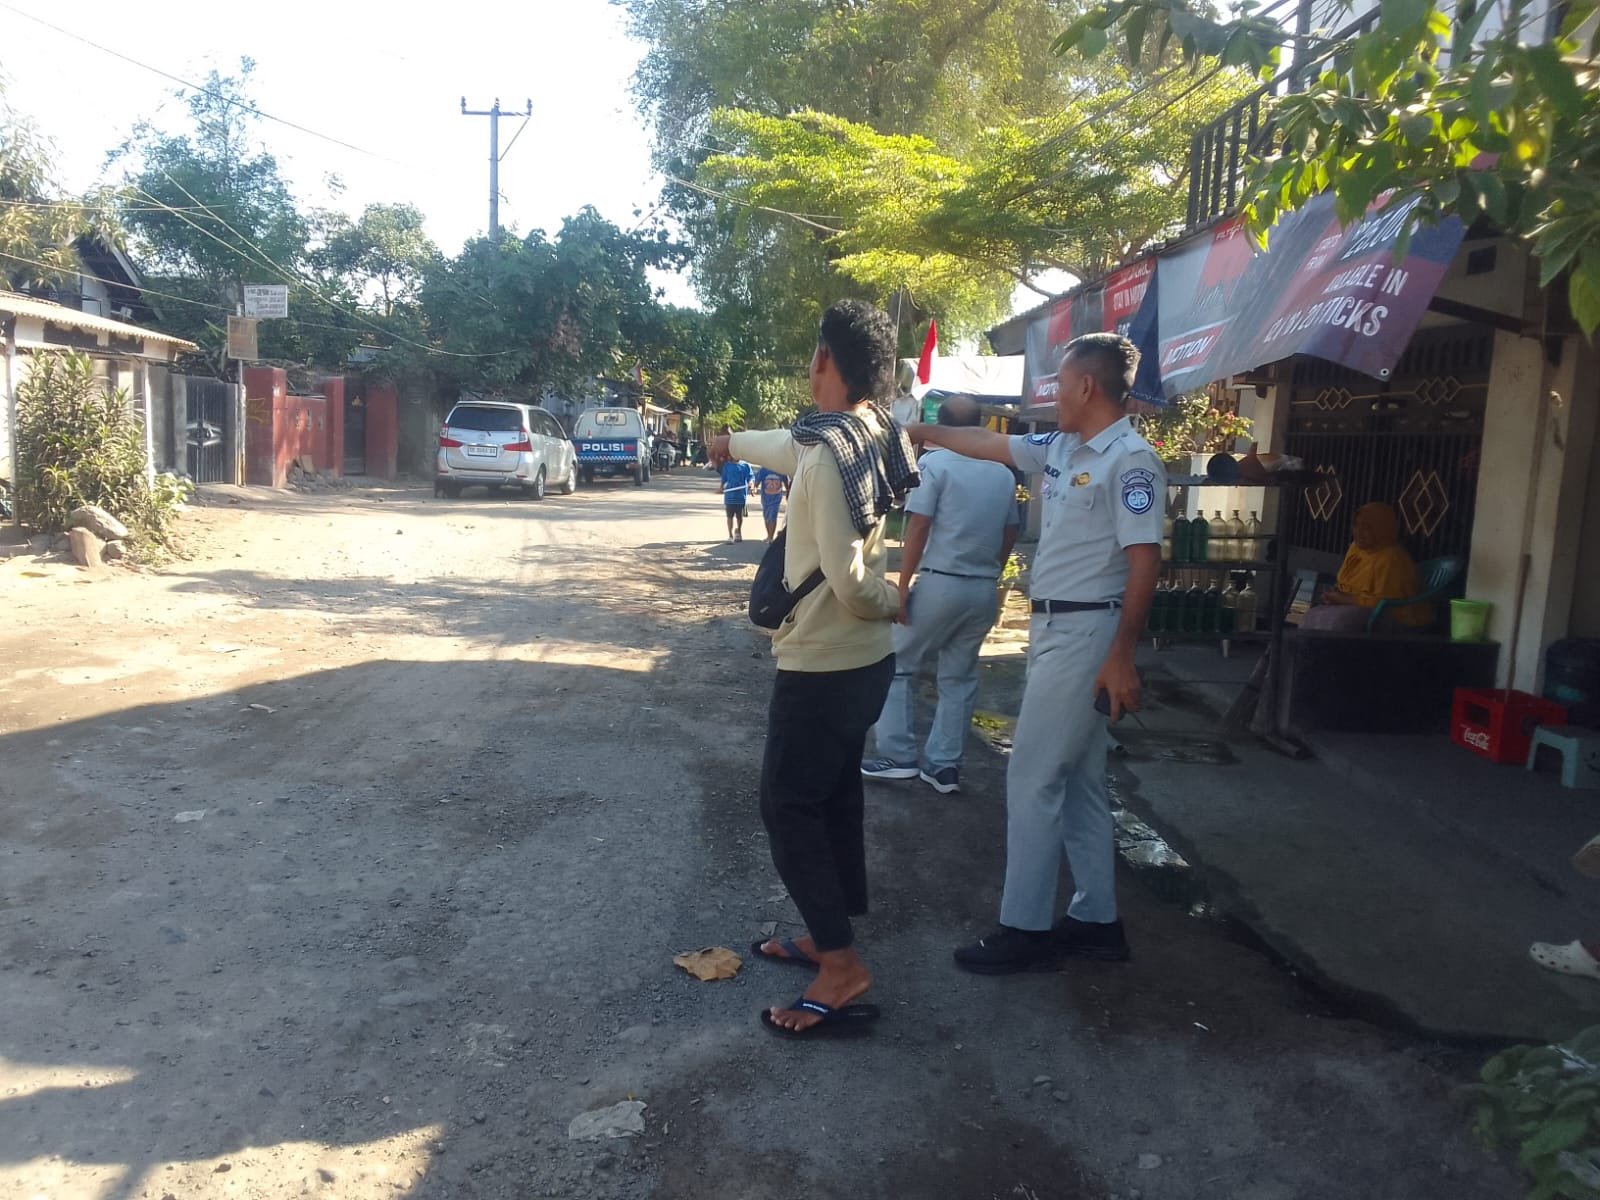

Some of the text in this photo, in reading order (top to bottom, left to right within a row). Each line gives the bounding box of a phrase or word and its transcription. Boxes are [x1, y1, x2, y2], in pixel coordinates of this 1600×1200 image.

[1381, 268, 1409, 296] IN
[1162, 335, 1214, 367] MOTION
[582, 443, 624, 452] POLISI
